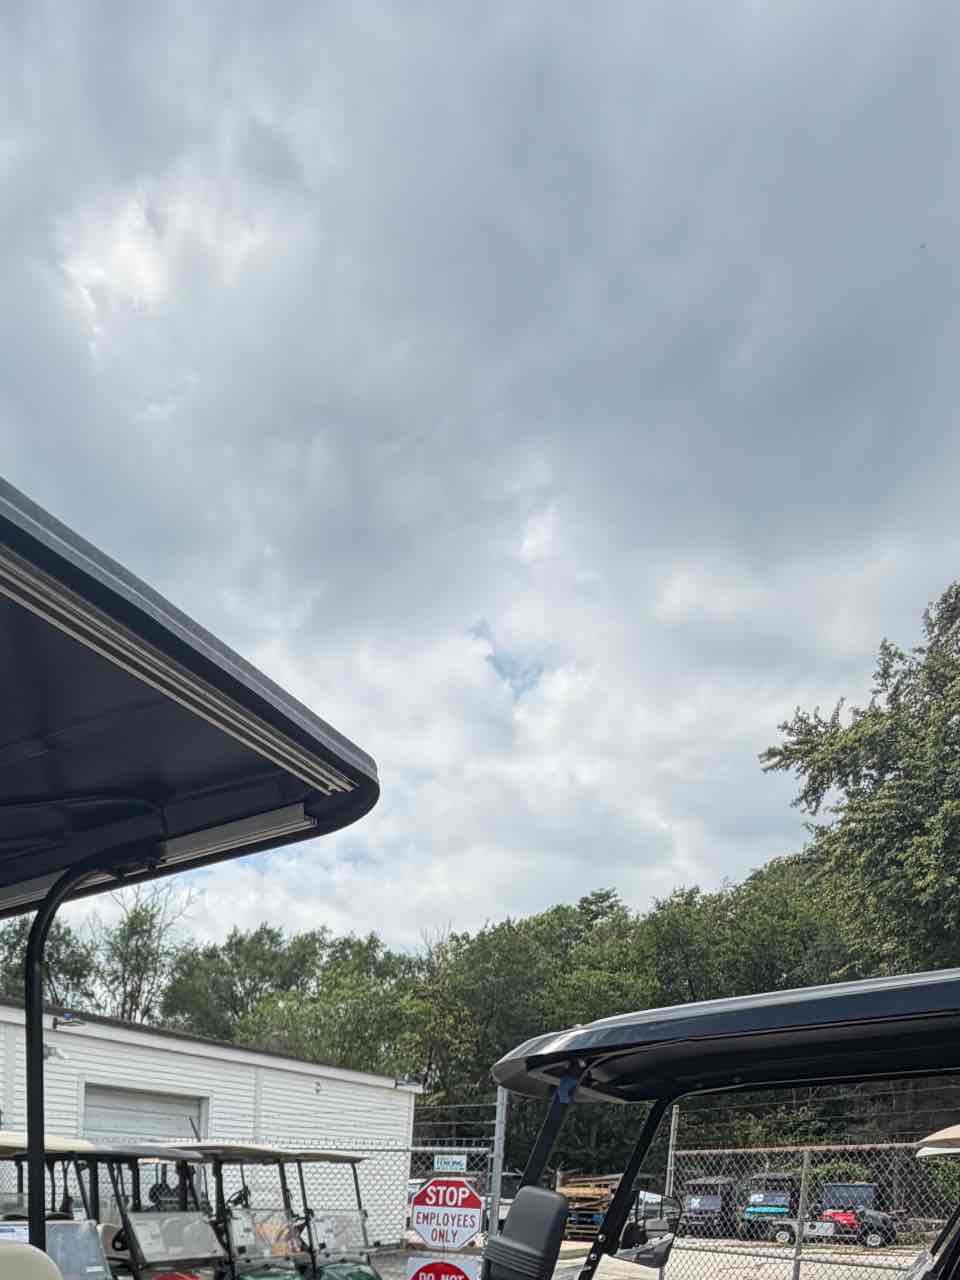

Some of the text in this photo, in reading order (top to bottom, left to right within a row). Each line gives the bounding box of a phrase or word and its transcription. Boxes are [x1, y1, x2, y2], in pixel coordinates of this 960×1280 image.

[425, 1185, 470, 1206] STOP
[416, 1211, 476, 1228] EMPLOYEES
[431, 1228, 459, 1243] ONLY
